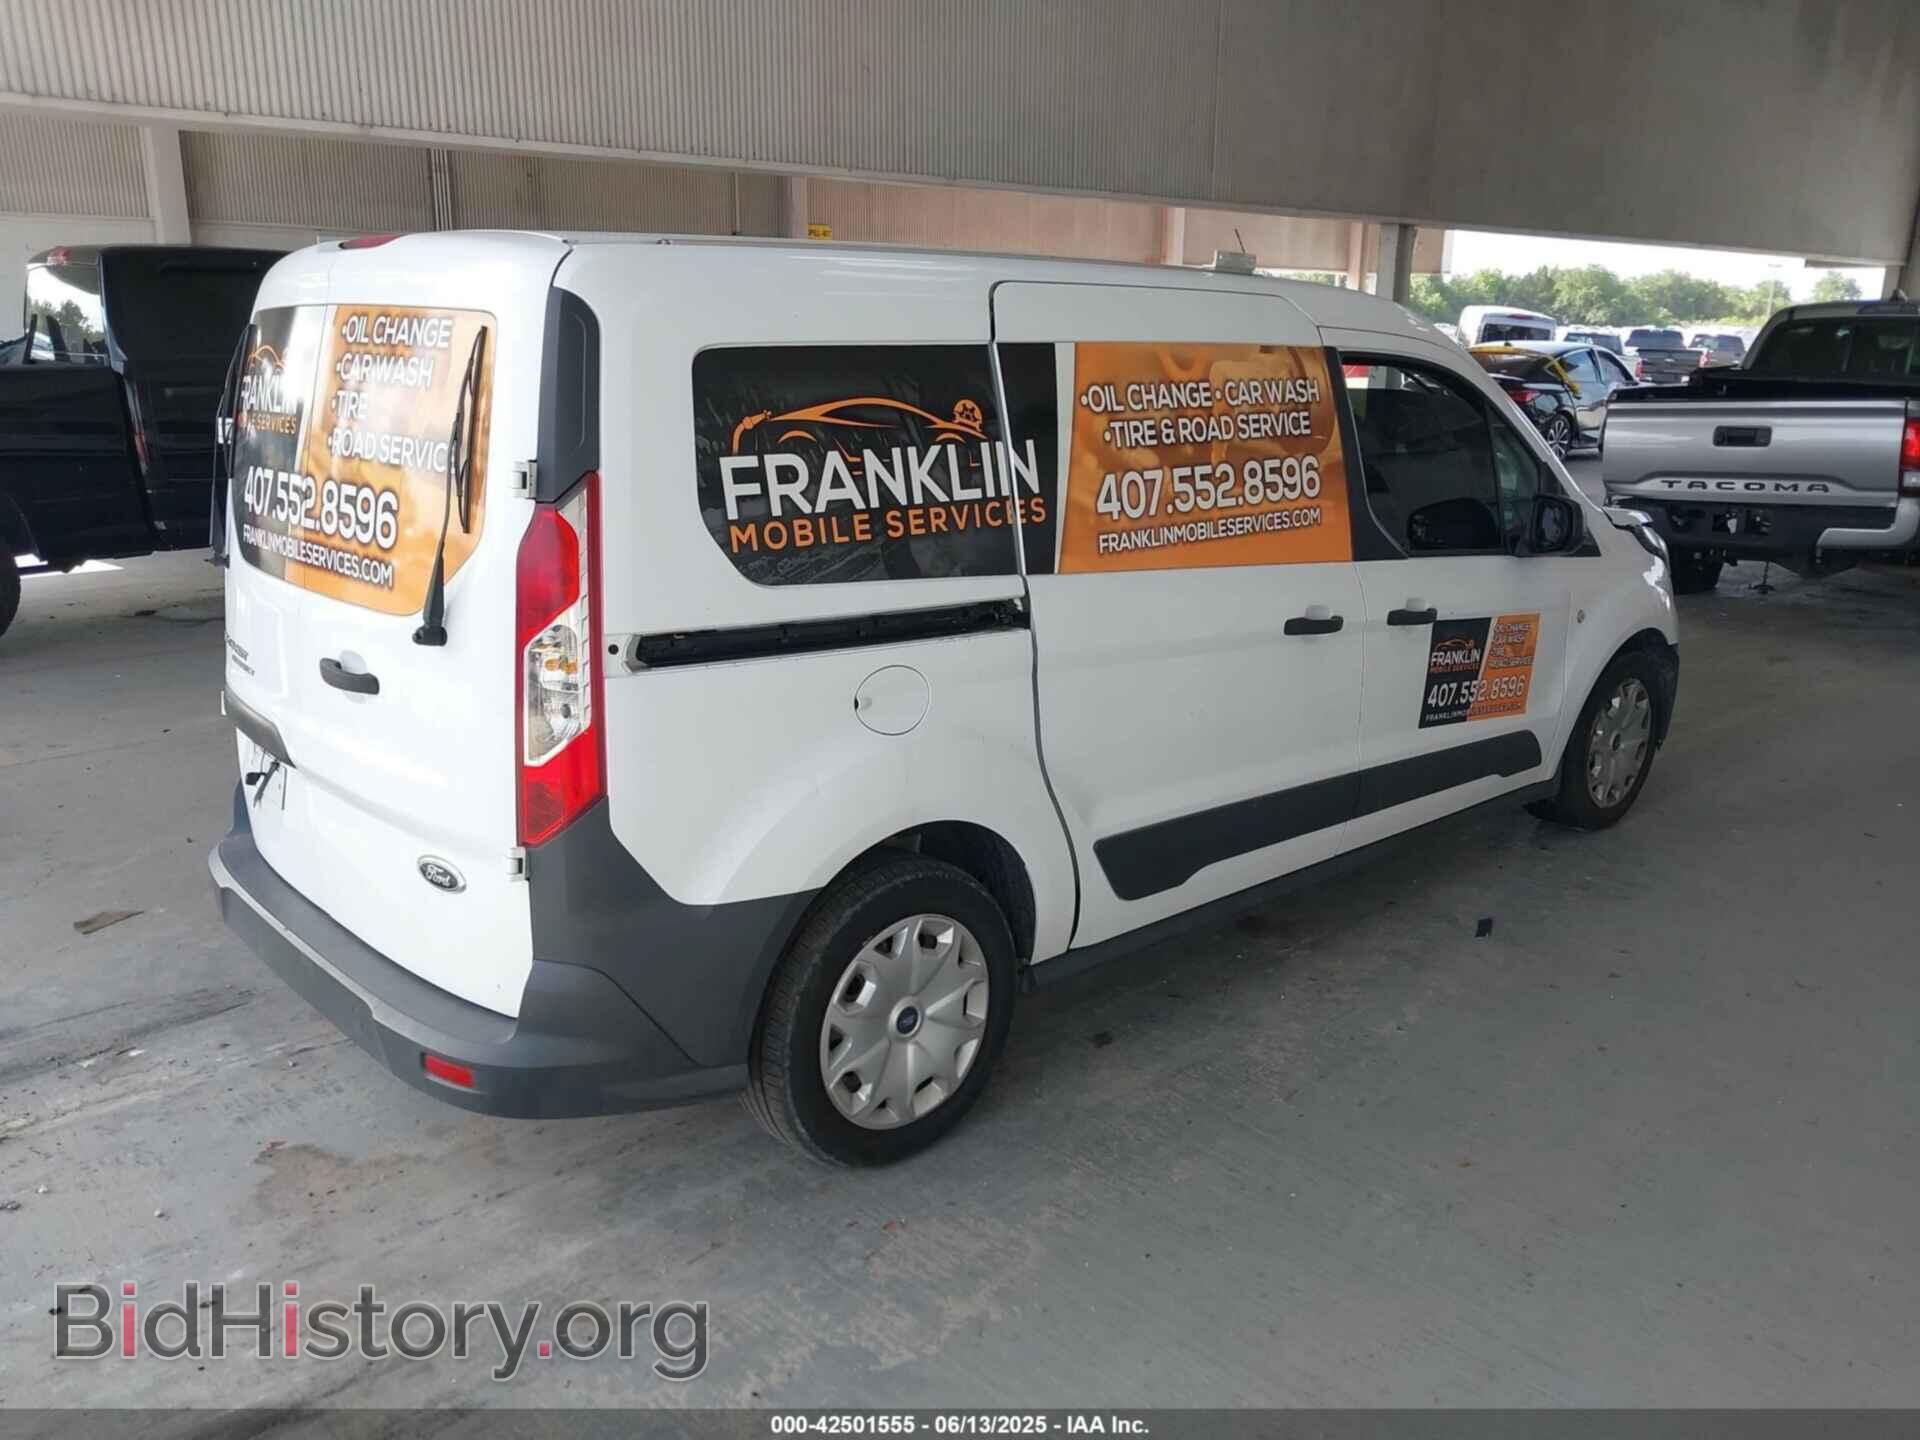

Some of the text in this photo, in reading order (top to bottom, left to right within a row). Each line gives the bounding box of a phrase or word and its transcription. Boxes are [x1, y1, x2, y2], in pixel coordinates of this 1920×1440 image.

[372, 317, 451, 348] CHANGE
[340, 353, 433, 386] CAR WASH
[1127, 382, 1211, 411] CHANGE
[1225, 380, 1261, 405] CAR
[1265, 378, 1320, 403] WASH
[1161, 420, 1176, 445] &
[1178, 415, 1234, 443] ROAD
[1237, 412, 1311, 438] SERVICE
[331, 428, 454, 473] ROAD SERVIC
[719, 439, 1040, 520] FRANKLIN
[1097, 455, 1320, 520] 407.552.8596
[1661, 480, 1831, 493] TACOMA
[244, 465, 398, 549] 407.552.8596
[729, 497, 1046, 553] MOBILE SERVICES
[1099, 507, 1321, 554] FRANKLINMOBILESERVICES.COM
[243, 524, 394, 587] FRANKLINMOBILESERVICES.COM
[1430, 648, 1480, 666] FRANKLIN
[1428, 675, 1525, 707] 407.552.8596
